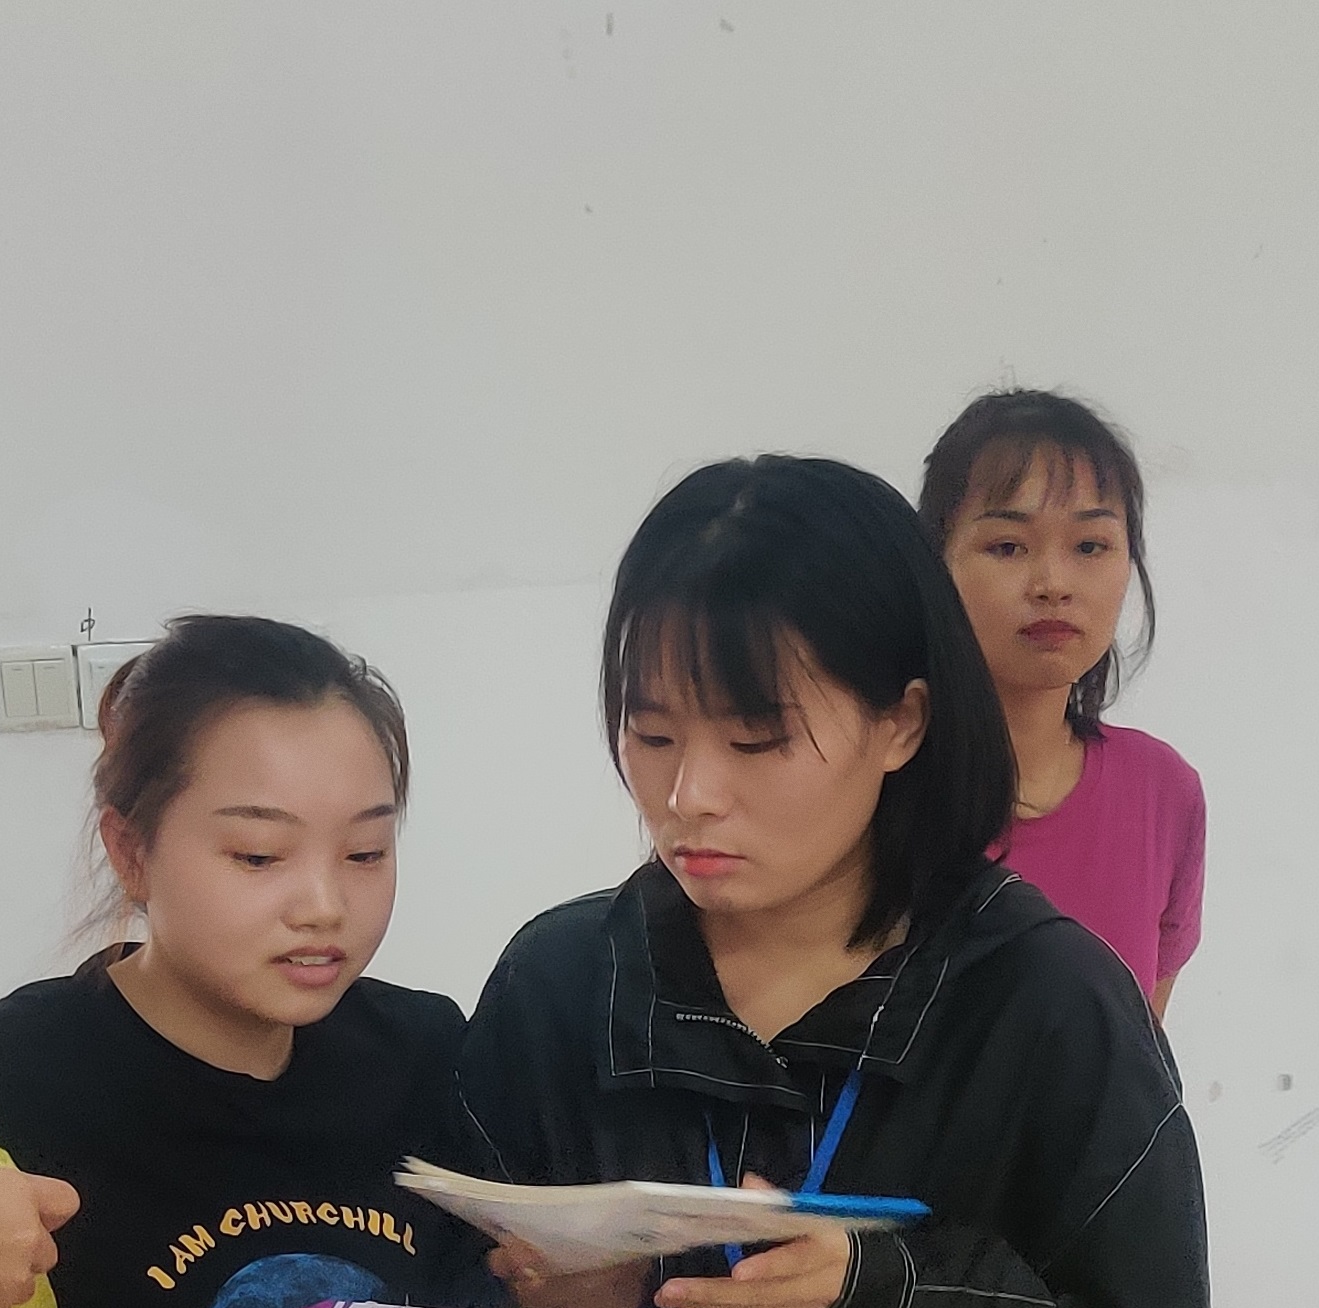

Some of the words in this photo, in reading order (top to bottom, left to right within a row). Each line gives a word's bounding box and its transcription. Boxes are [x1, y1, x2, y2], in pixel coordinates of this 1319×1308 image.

[147, 1266, 175, 1289] I
[169, 1225, 215, 1274] AM
[219, 1201, 416, 1255] CHURCHILL
